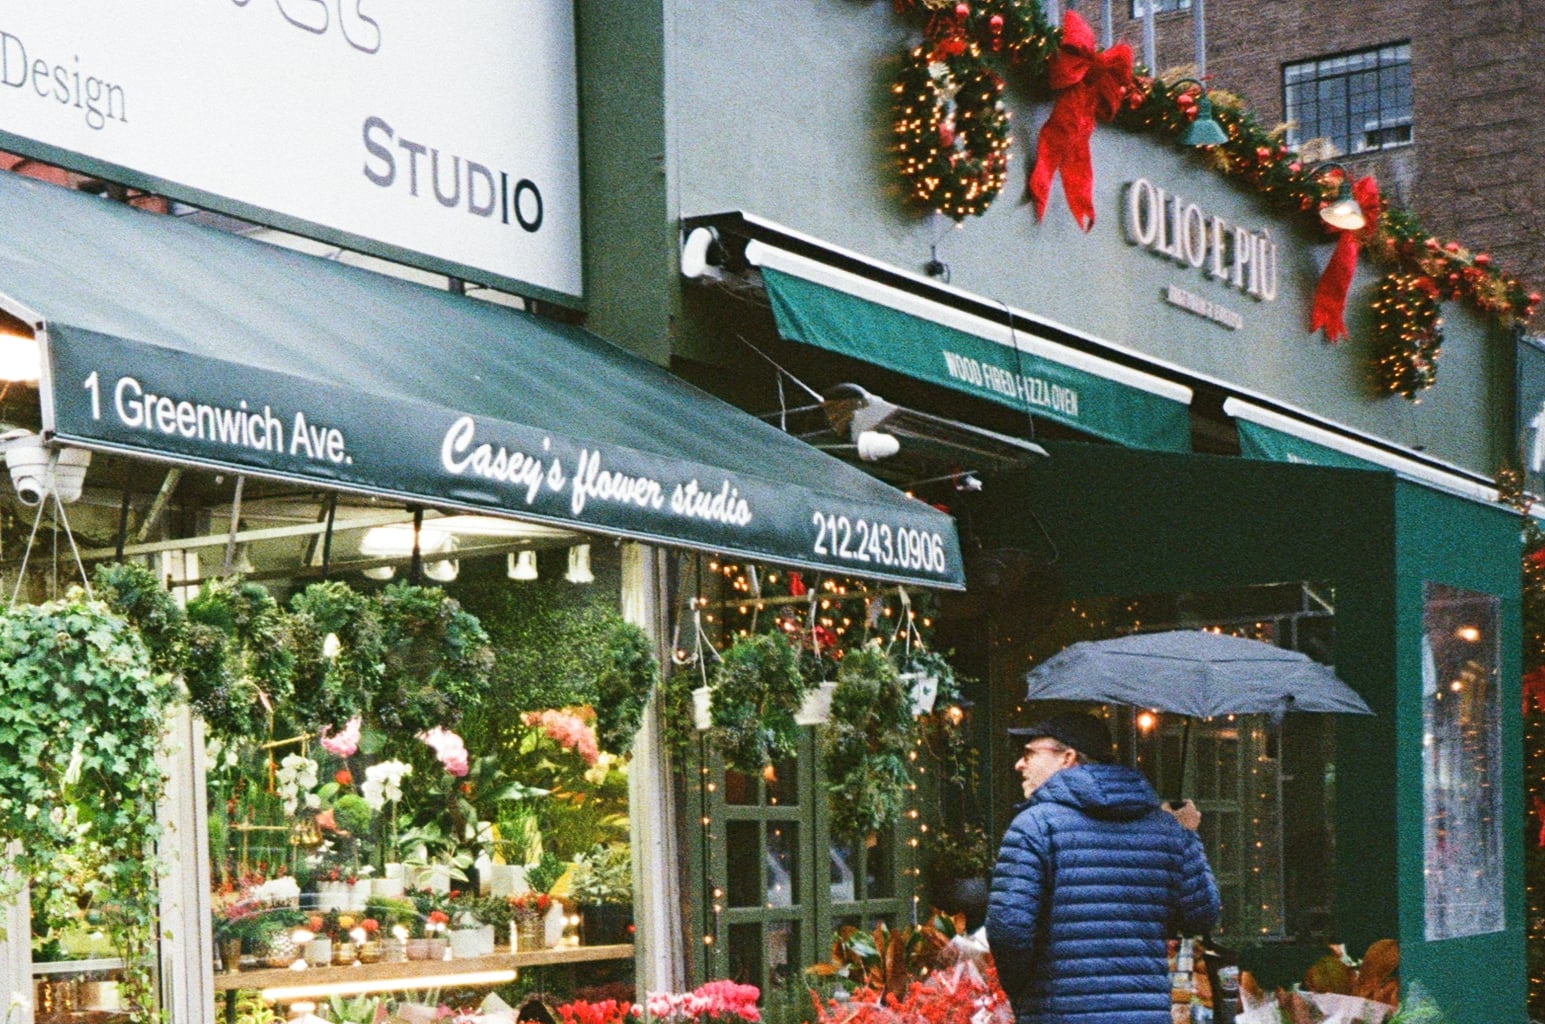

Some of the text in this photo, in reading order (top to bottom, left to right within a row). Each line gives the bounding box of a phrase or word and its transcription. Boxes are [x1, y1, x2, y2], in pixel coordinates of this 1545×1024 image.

[0, 30, 128, 130] Design
[362, 115, 543, 233] STUDIO
[1130, 178, 1206, 268] OLIO
[1211, 215, 1229, 280] E
[84, 371, 353, 465] 1 Greenwich Ave.
[943, 350, 983, 387] WOOD
[982, 363, 1018, 398] FIRED
[1051, 384, 1079, 417] OVEN
[441, 415, 752, 526] Casey's flower studio
[813, 510, 946, 573] 212.243.0906
